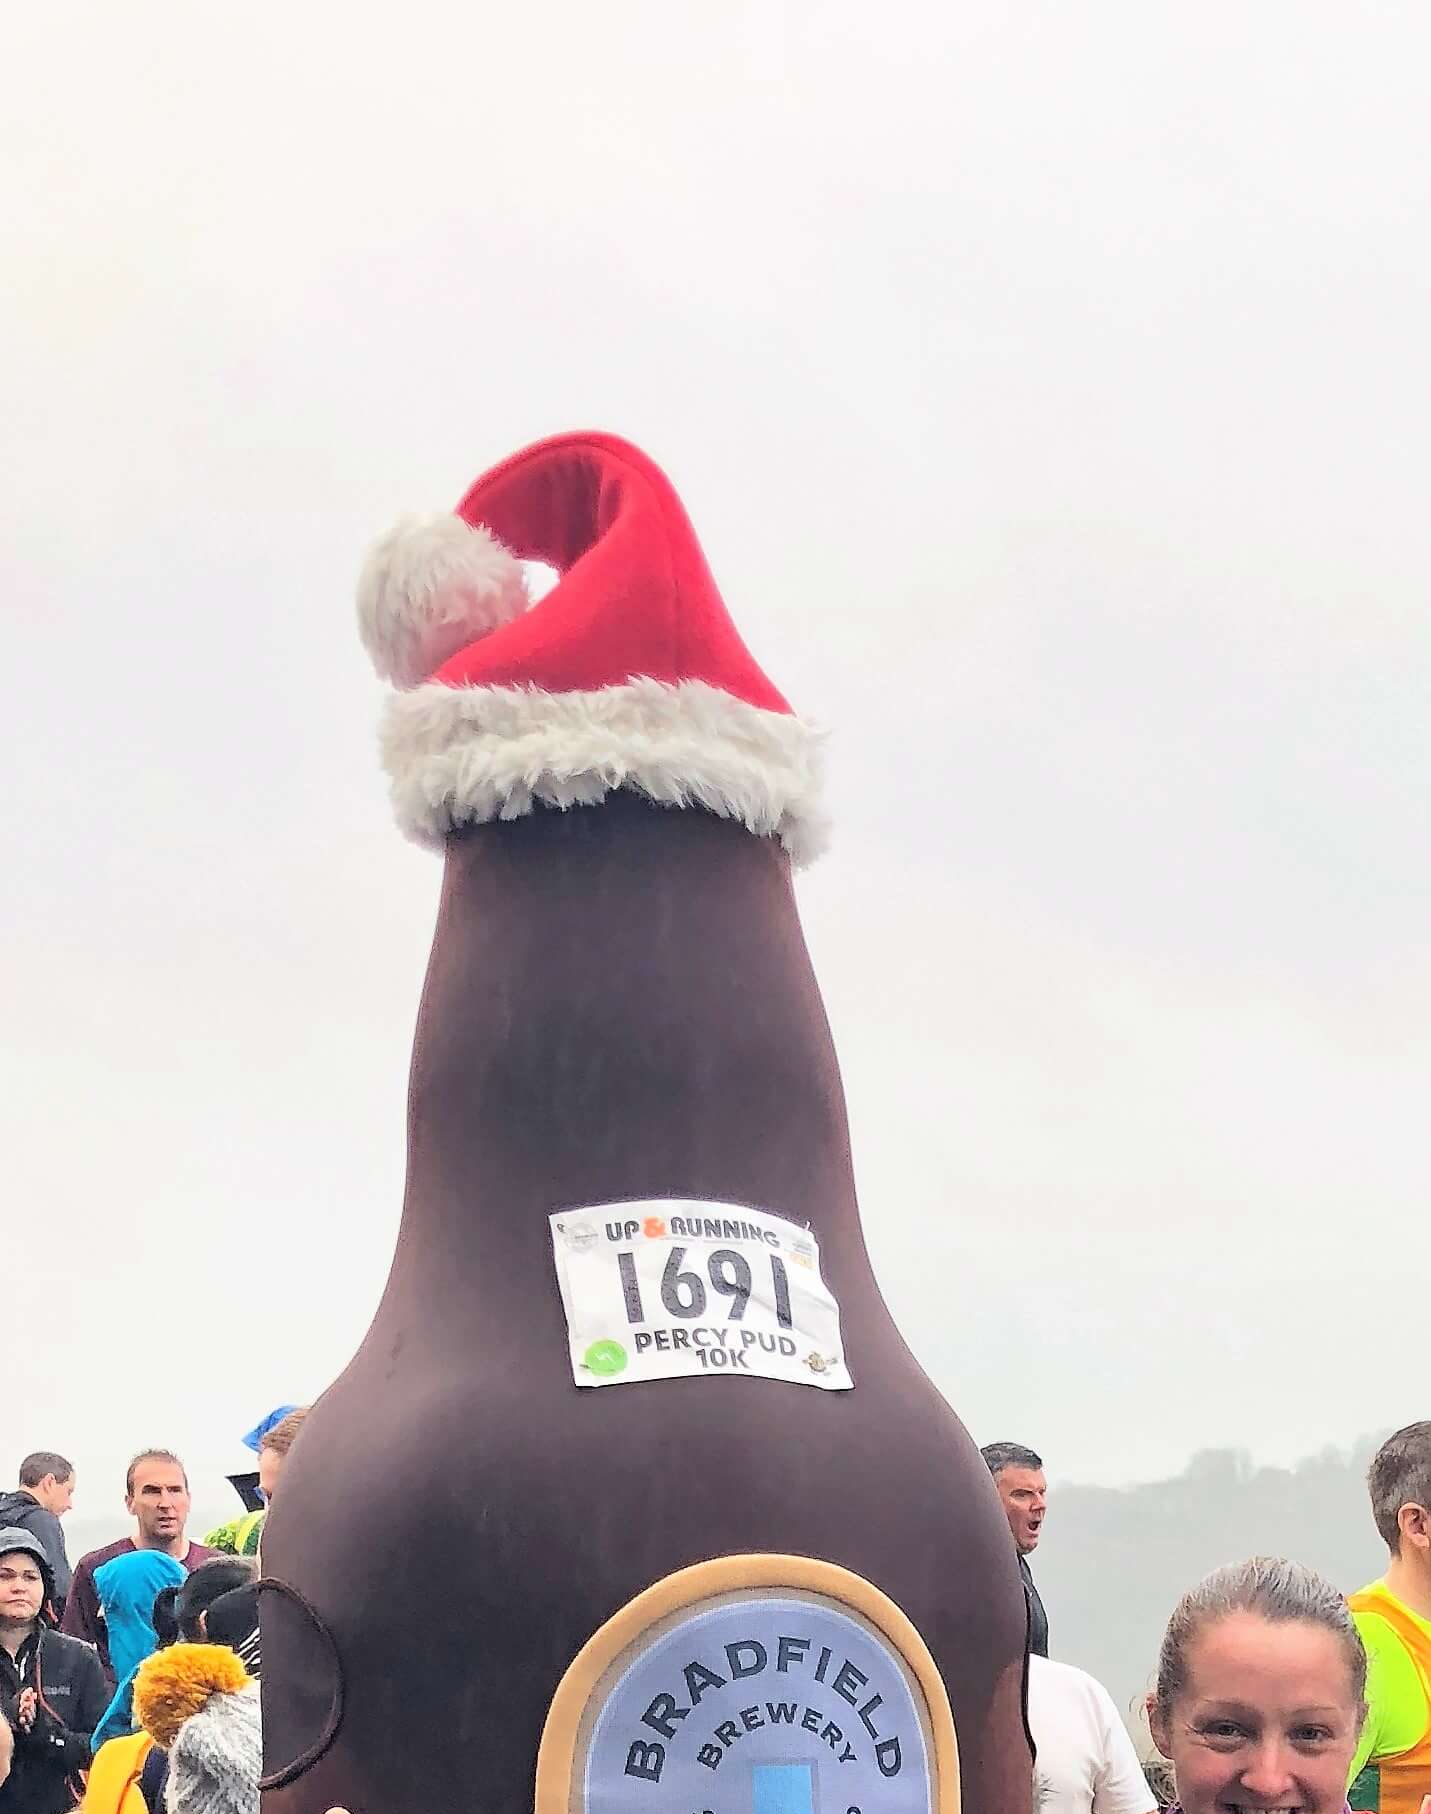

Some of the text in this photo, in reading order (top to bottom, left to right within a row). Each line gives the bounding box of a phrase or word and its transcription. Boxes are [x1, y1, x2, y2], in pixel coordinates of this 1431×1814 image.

[605, 1220, 639, 1241] UP
[670, 1216, 780, 1248] RUNNING
[617, 1246, 793, 1330] 1691
[635, 1328, 797, 1356] PERCY PUD
[696, 1348, 751, 1369] 10K
[624, 1636, 902, 1783] BRADFIELD
[697, 1702, 857, 1770] BREWERY
